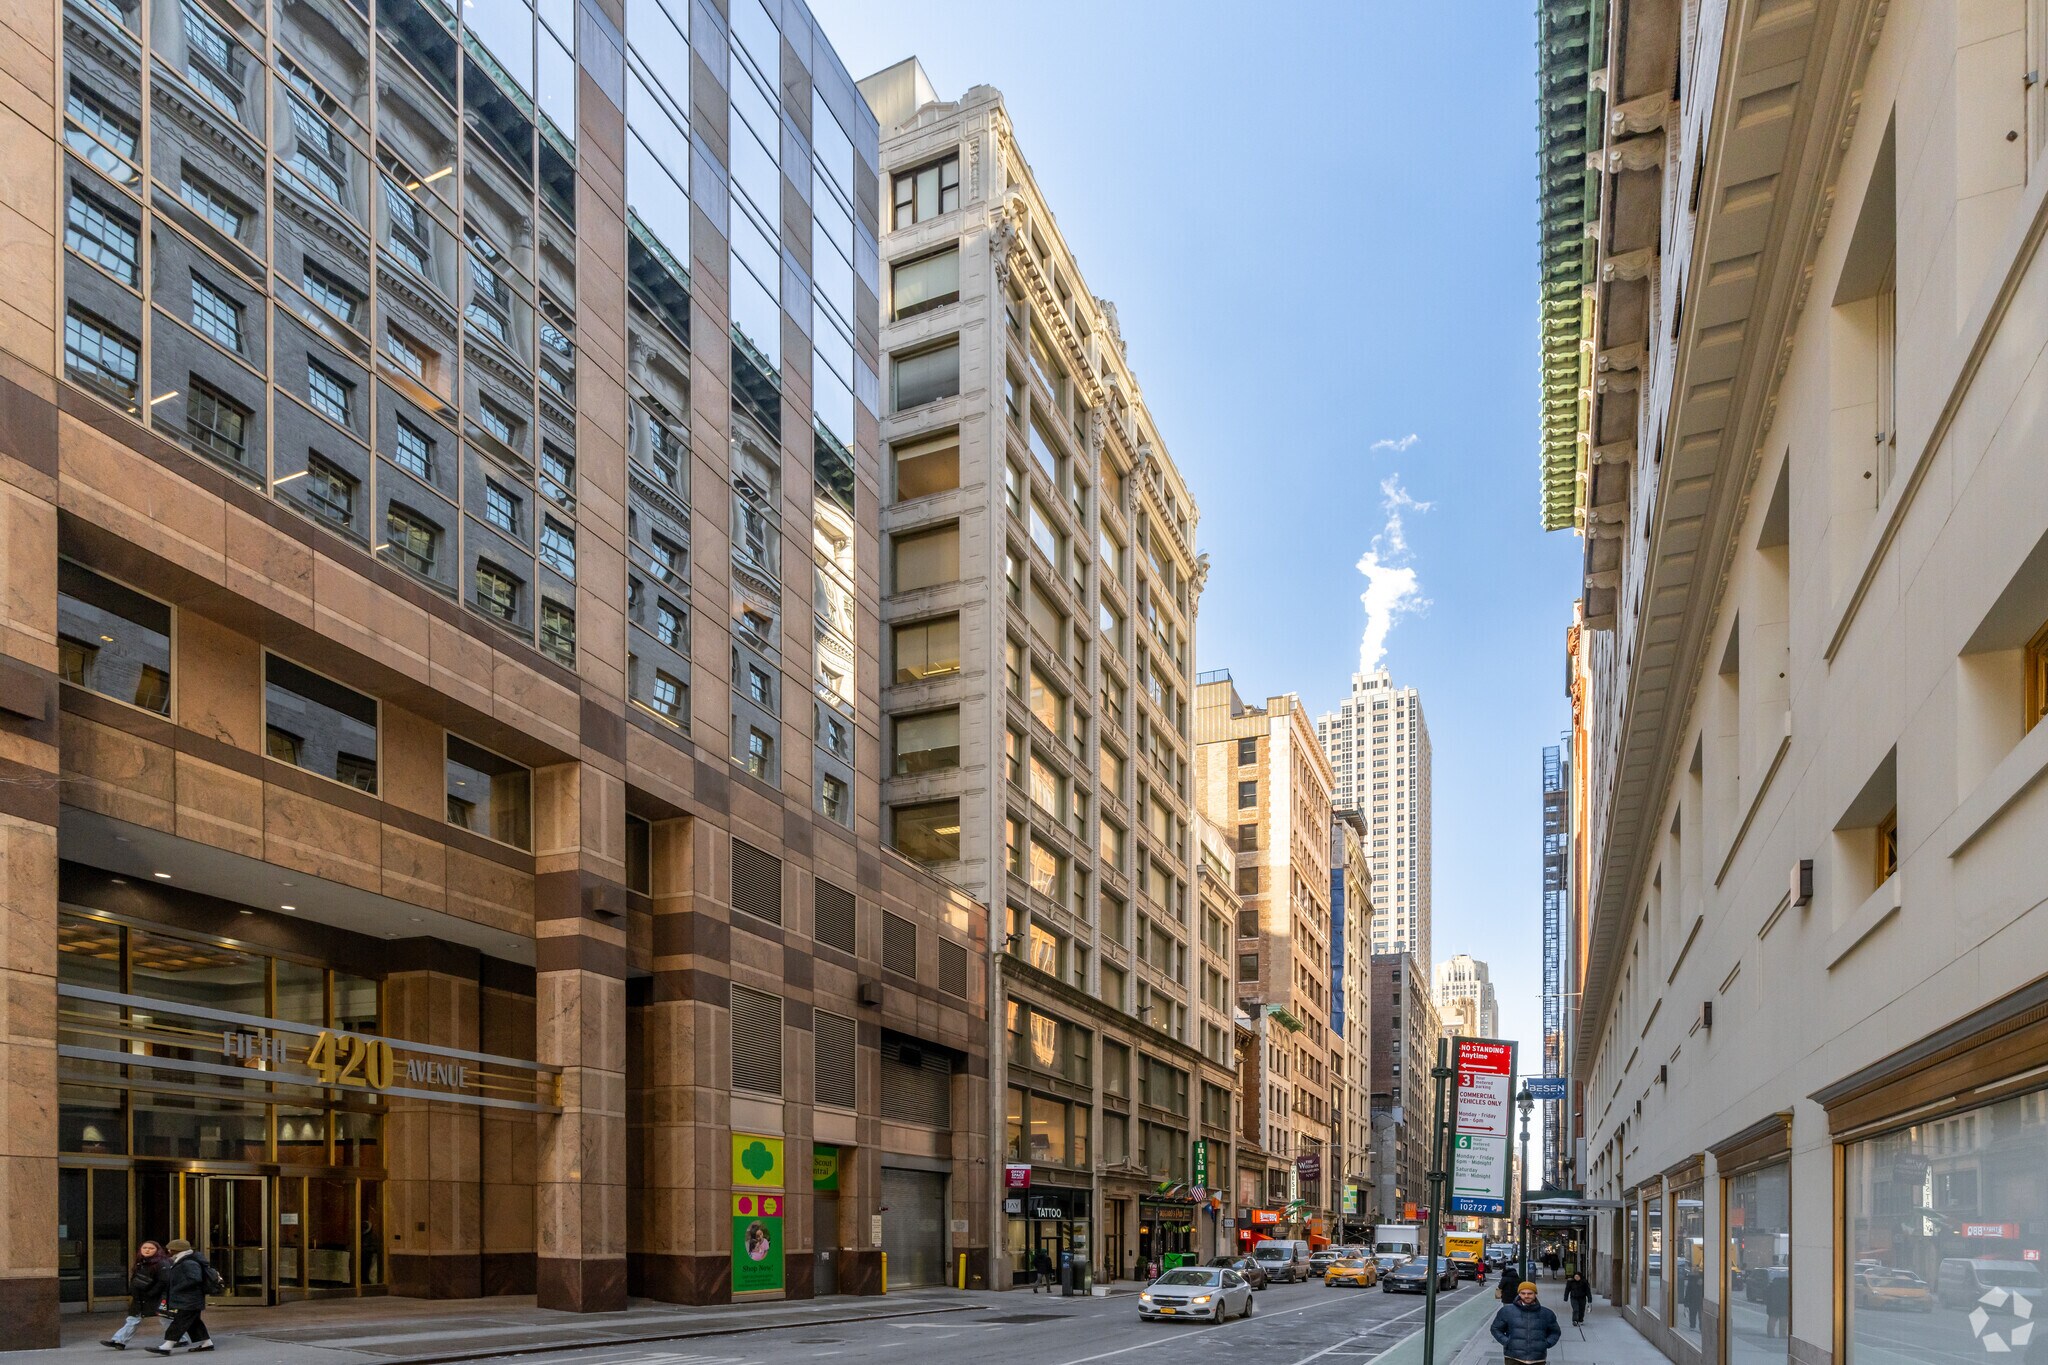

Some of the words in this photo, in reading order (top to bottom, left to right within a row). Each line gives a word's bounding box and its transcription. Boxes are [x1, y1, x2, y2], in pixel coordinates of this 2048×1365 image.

[1472, 1046, 1504, 1054] STANDING
[1461, 1051, 1488, 1060] Anytime
[224, 1031, 286, 1063] FIFTH
[307, 1031, 394, 1089] 420
[406, 1059, 469, 1088] AVENUE
[1461, 1074, 1471, 1087] 3
[1530, 1084, 1564, 1092] BESEN
[1460, 1091, 1496, 1099] COMMERCIAL
[1459, 1136, 1468, 1148] 6
[815, 1159, 832, 1167] Scout
[1460, 1203, 1487, 1211] 102727
[1037, 1207, 1062, 1218] TATTOO
